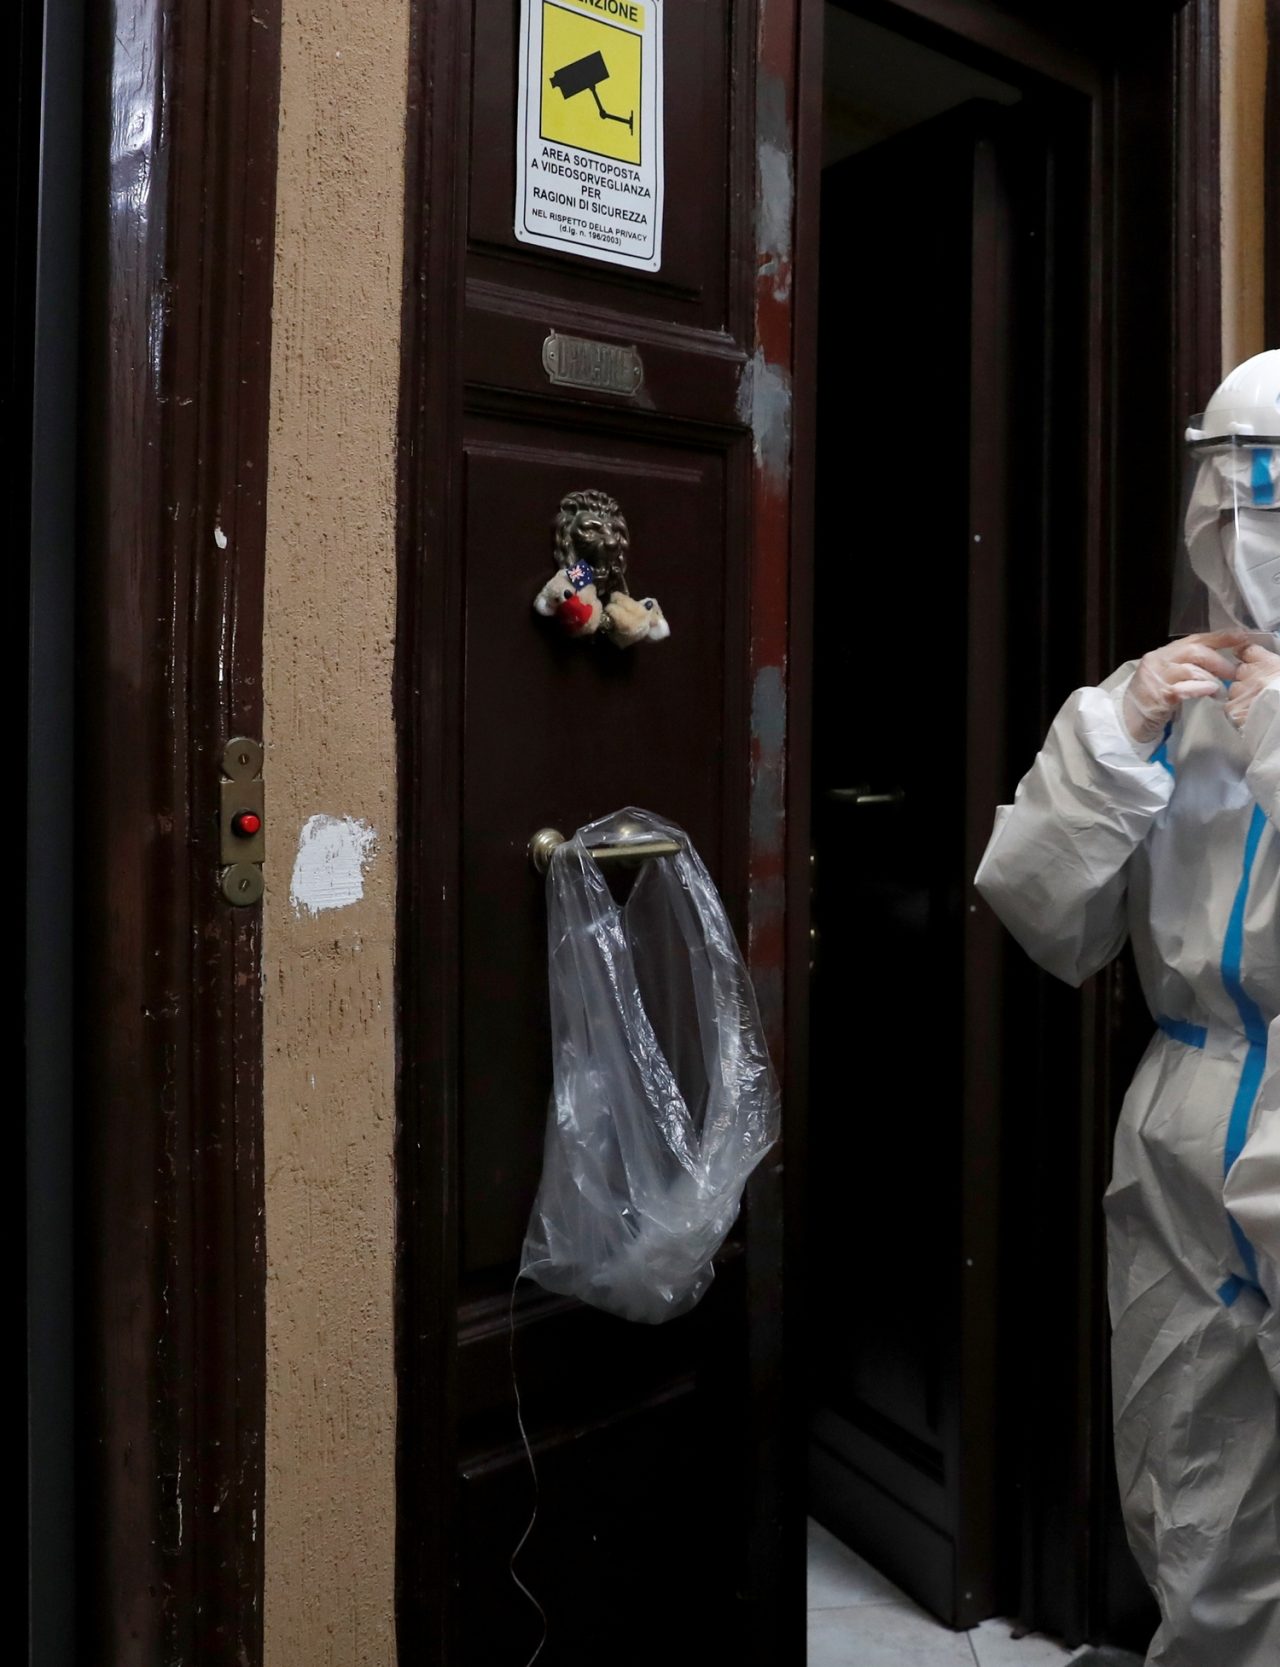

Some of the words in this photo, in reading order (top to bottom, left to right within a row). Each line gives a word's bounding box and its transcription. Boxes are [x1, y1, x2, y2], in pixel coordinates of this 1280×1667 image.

[531, 158, 539, 169] A
[542, 161, 651, 198] VIDEOSORVEGLIANZA
[542, 147, 570, 163] AREA
[573, 155, 640, 182] SOTTOPOSTA
[533, 187, 576, 207] RAGIONI
[579, 199, 589, 211] DI
[592, 202, 648, 225] SICUREZZA
[581, 185, 601, 200] PER
[532, 208, 547, 219] NEL
[549, 212, 587, 228] RISPETTO
[589, 222, 613, 235] DELLA
[615, 228, 647, 242] PRIVACY
